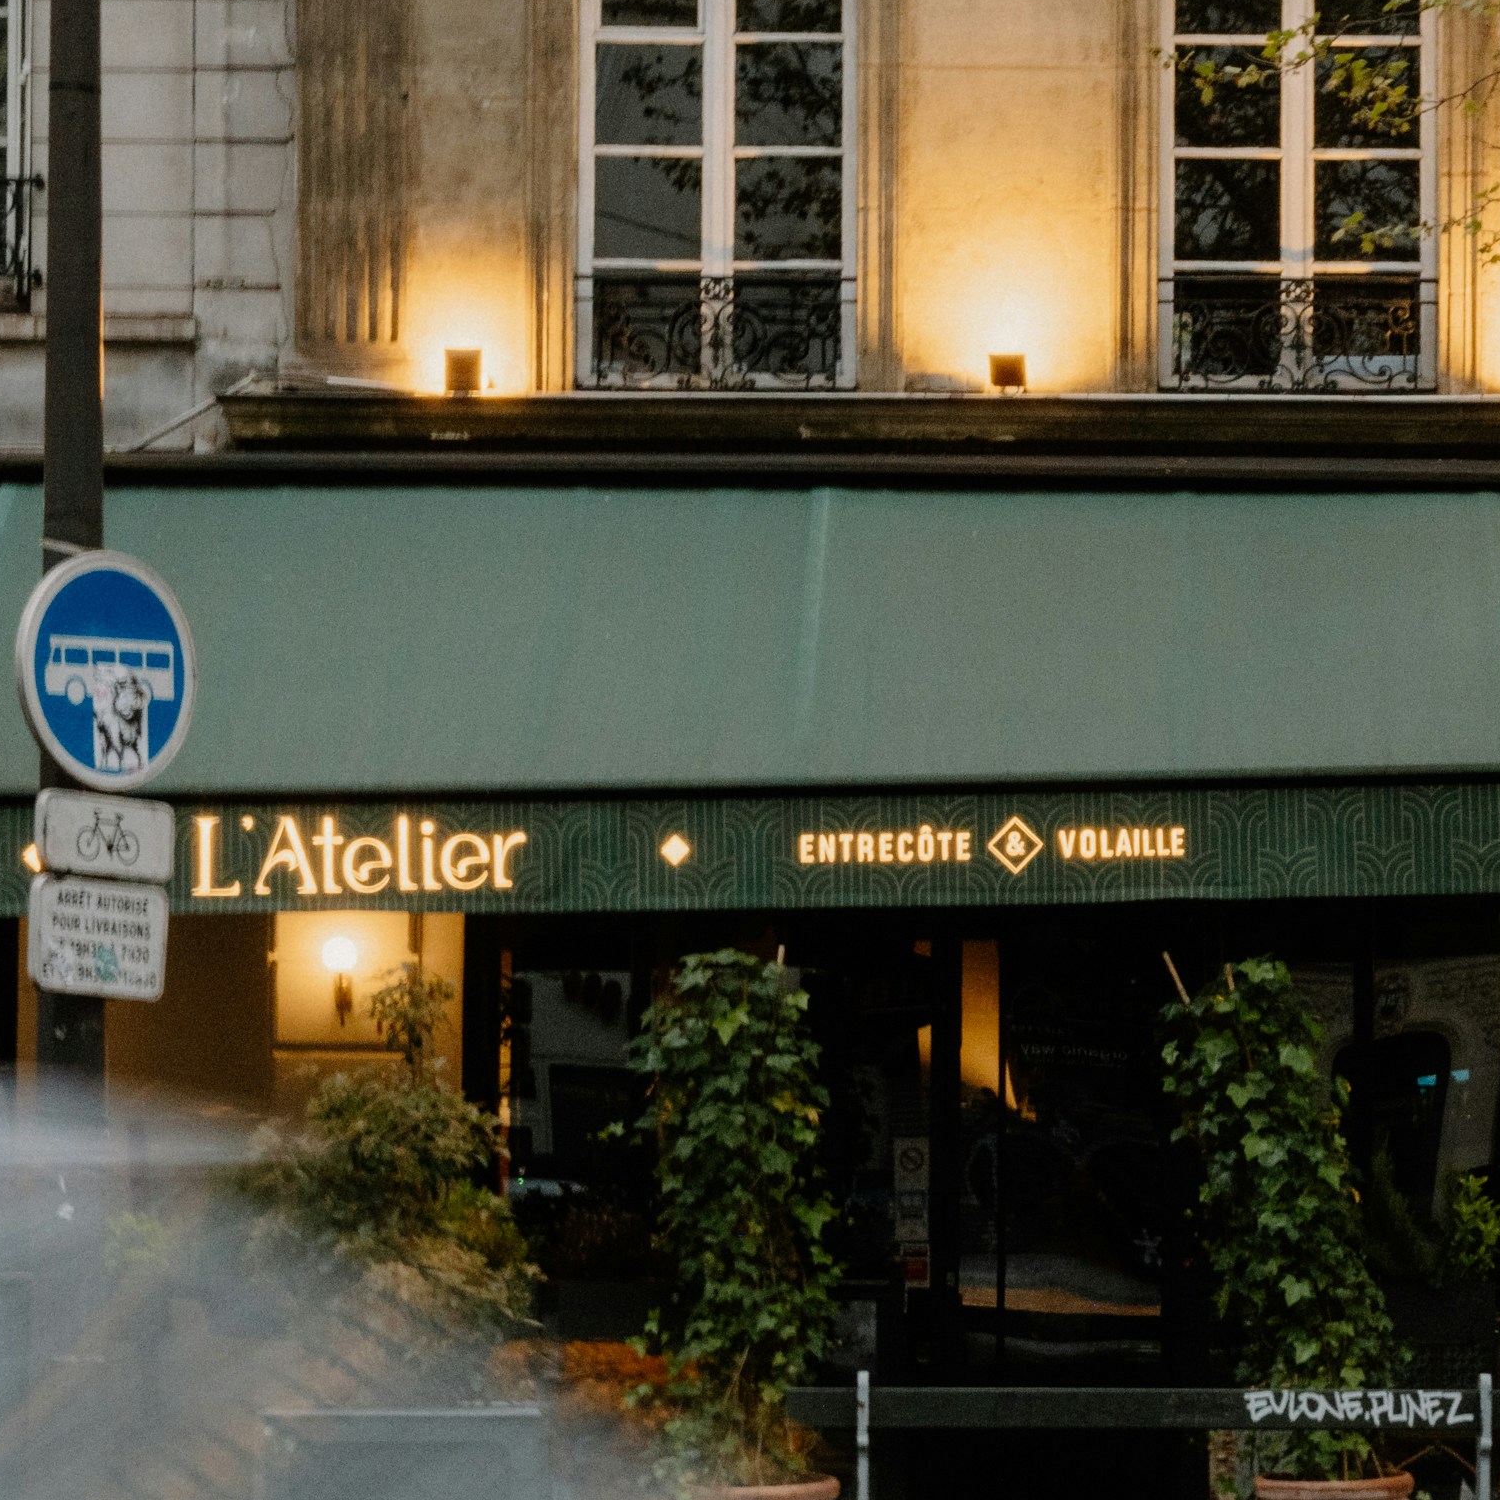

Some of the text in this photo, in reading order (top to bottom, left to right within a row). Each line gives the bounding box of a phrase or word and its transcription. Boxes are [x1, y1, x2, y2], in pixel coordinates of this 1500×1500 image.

[193, 814, 528, 898] L'Atelier
[800, 825, 1186, 864] ENTRECÔTE & VOLAILLE
[84, 914, 152, 941] LIVRAISONS
